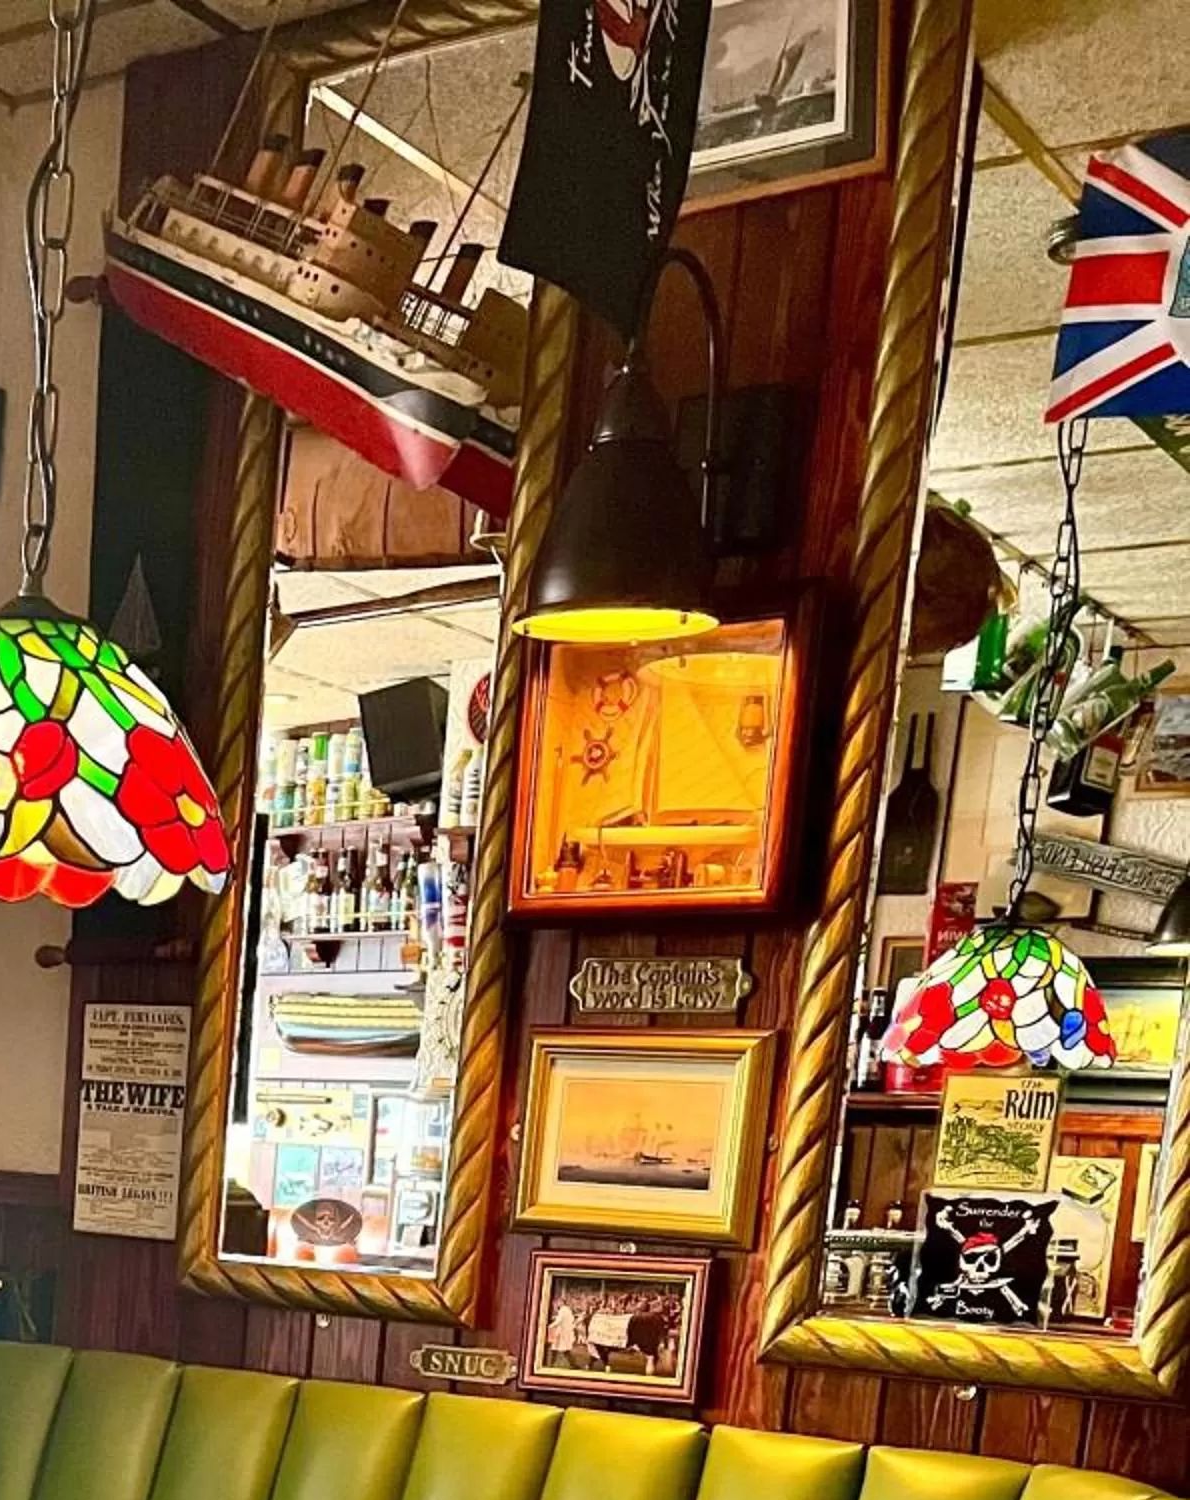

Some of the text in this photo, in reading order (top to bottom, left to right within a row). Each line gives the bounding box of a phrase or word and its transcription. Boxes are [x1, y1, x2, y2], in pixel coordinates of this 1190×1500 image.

[588, 961, 721, 991] The Captain's
[650, 987, 667, 1008] is
[81, 1080, 186, 1109] THE WIFE
[955, 1201, 1022, 1217] Surrender
[955, 1299, 995, 1319] Booty
[429, 1352, 497, 1378] SNUG
